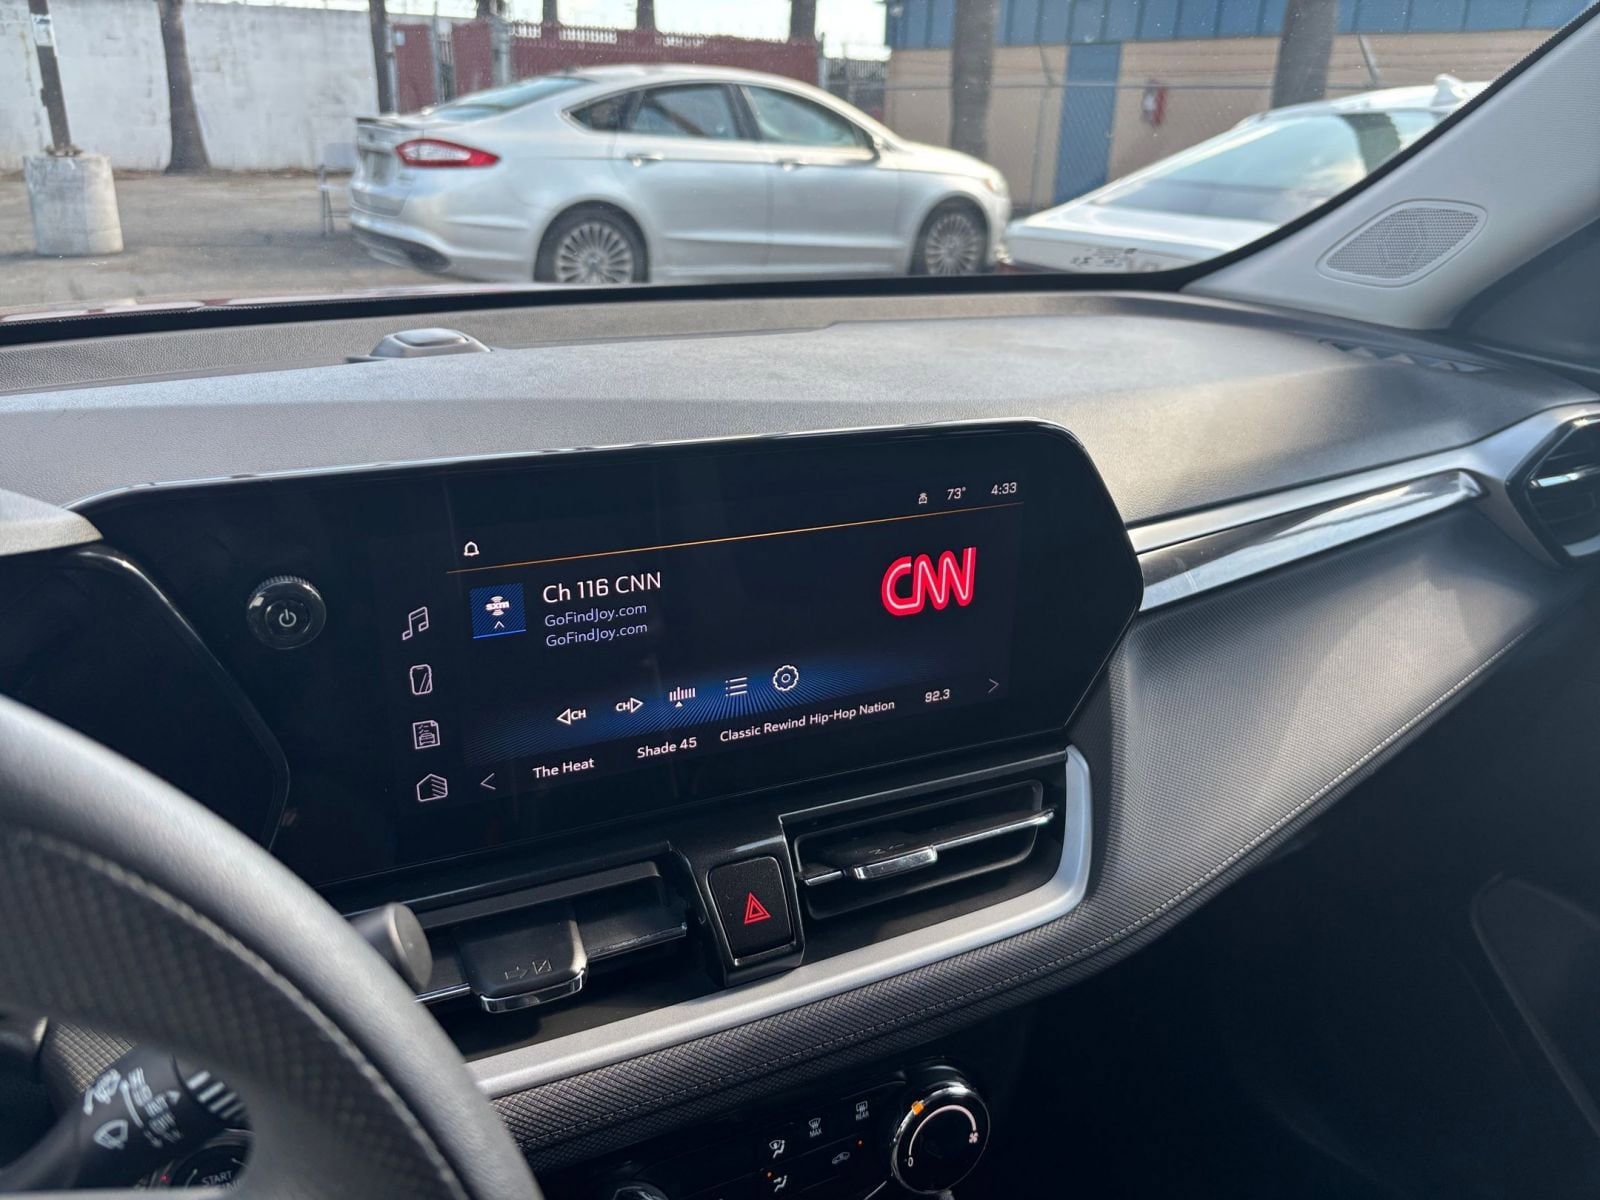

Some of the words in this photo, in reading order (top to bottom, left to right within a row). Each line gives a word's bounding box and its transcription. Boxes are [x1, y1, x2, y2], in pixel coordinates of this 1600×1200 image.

[990, 481, 1018, 496] 4:33
[542, 582, 571, 604] Ch
[576, 578, 610, 600] 116
[615, 571, 662, 594] CNN
[881, 547, 977, 616] CNN
[544, 604, 648, 628] GoFindJoy.com
[545, 623, 648, 647] GoFindJoy.com
[615, 701, 630, 712] CH
[924, 688, 951, 703] 92.3
[571, 709, 587, 720] CH
[719, 724, 762, 743] Classic
[763, 715, 807, 735] Rewind
[809, 708, 857, 728] Hip-Hop
[858, 700, 896, 717] Nation
[637, 741, 677, 759] Shade
[679, 736, 698, 750] 45
[532, 765, 560, 780] The
[562, 756, 596, 775] Heat
[809, 1128, 822, 1138] MAX
[201, 1170, 233, 1188] START
